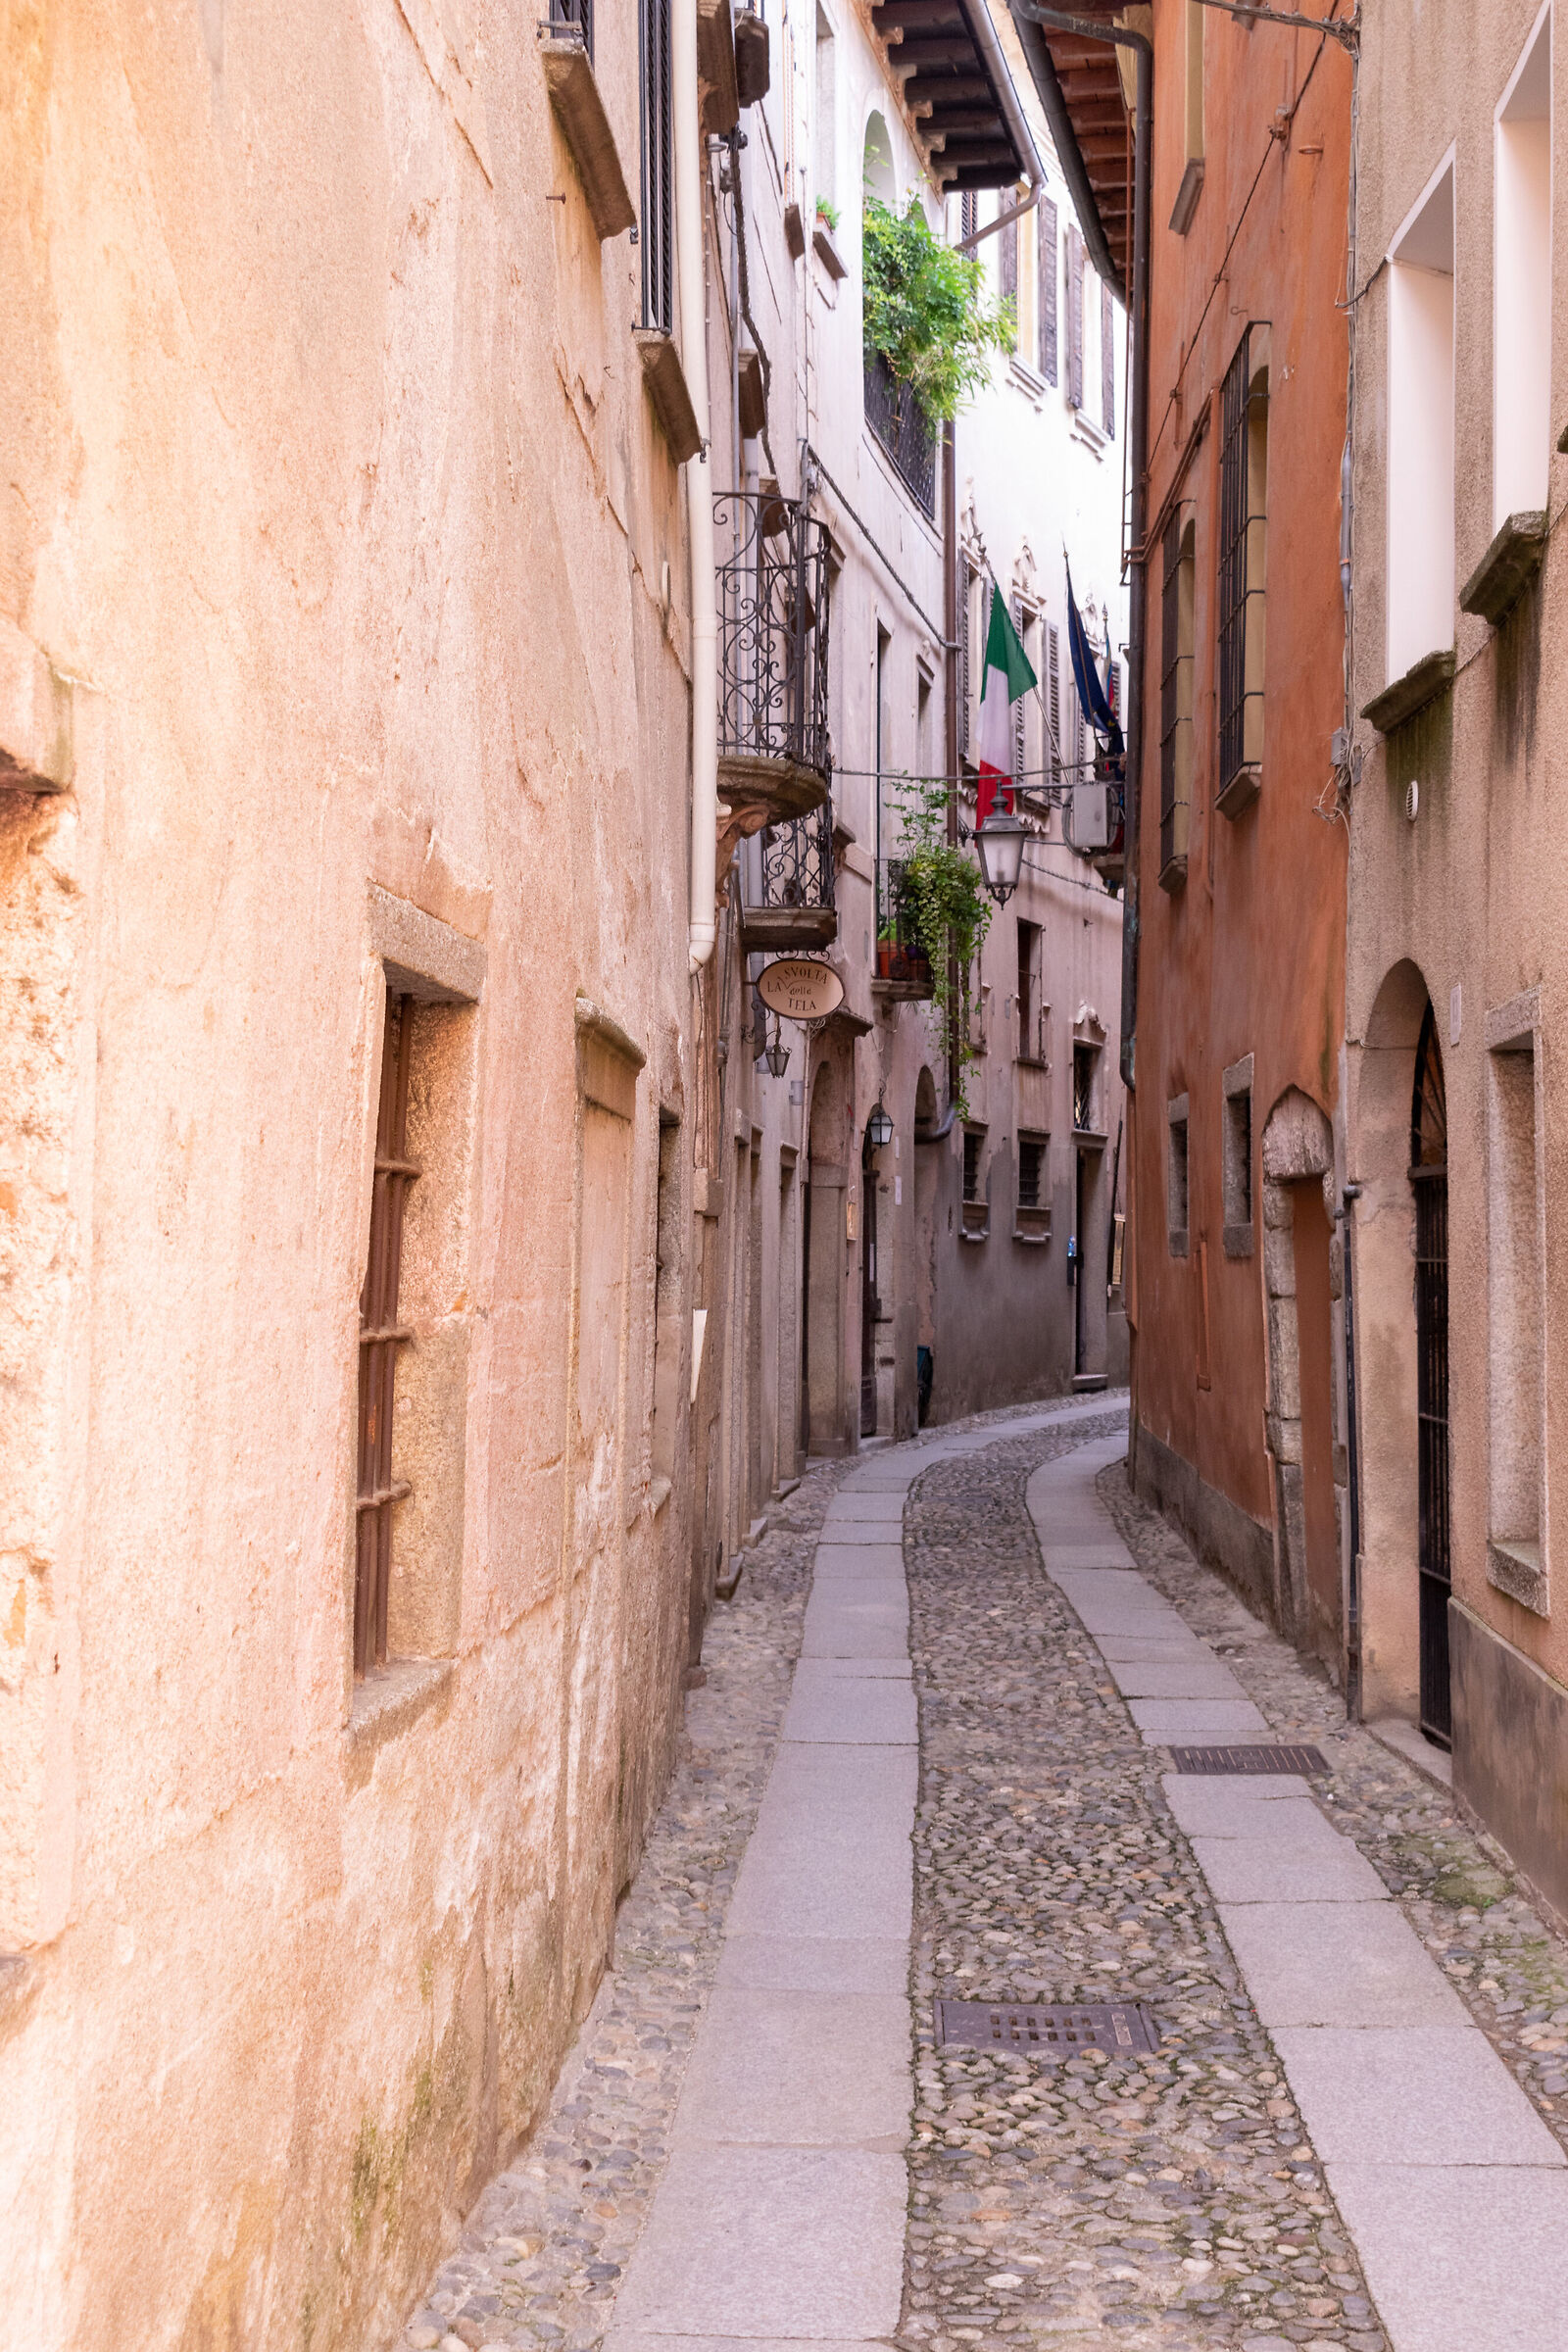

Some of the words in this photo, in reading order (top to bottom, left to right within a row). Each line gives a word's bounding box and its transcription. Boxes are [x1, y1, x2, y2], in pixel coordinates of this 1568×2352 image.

[767, 981, 782, 993] LA
[784, 966, 827, 985] SVOLTA
[788, 998, 816, 1011] TELA
